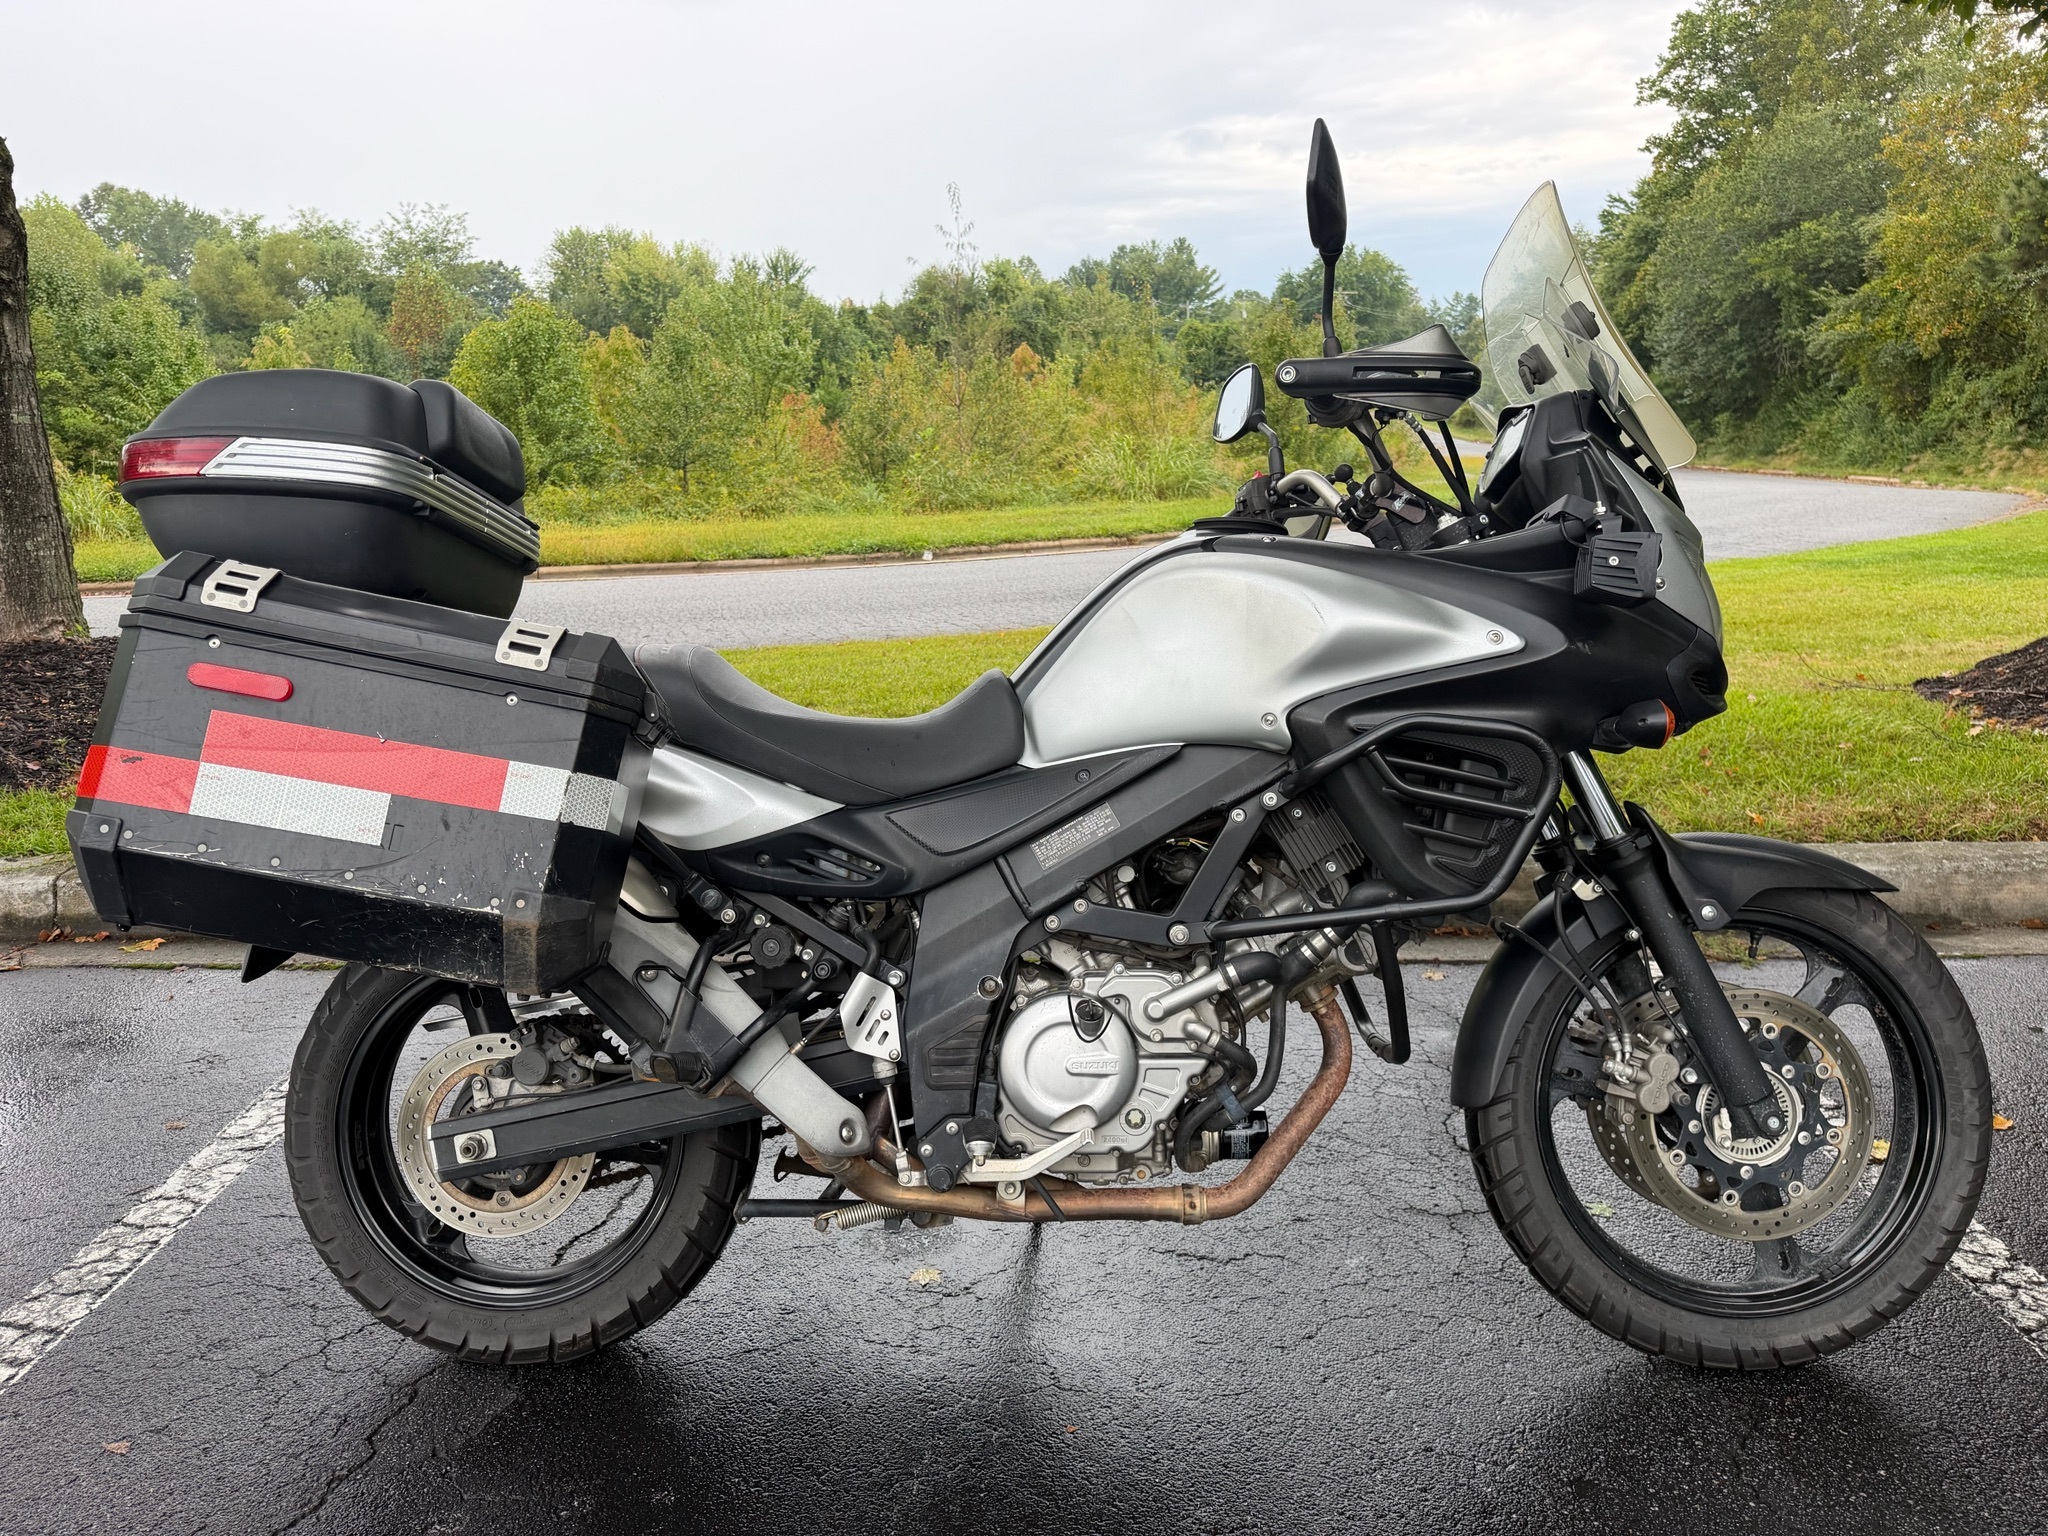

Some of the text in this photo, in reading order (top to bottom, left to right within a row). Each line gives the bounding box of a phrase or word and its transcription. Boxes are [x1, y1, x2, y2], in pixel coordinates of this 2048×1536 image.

[319, 986, 384, 1084] MASTER
[1071, 1060, 1119, 1070] SUZUKI
[1651, 1061, 1670, 1106] TOKICO
[1939, 1043, 1965, 1138] SHINKO
[312, 1095, 331, 1178] TRAIL
[1102, 1136, 1128, 1144] 2400ml
[328, 1209, 428, 1312] SHINKO
